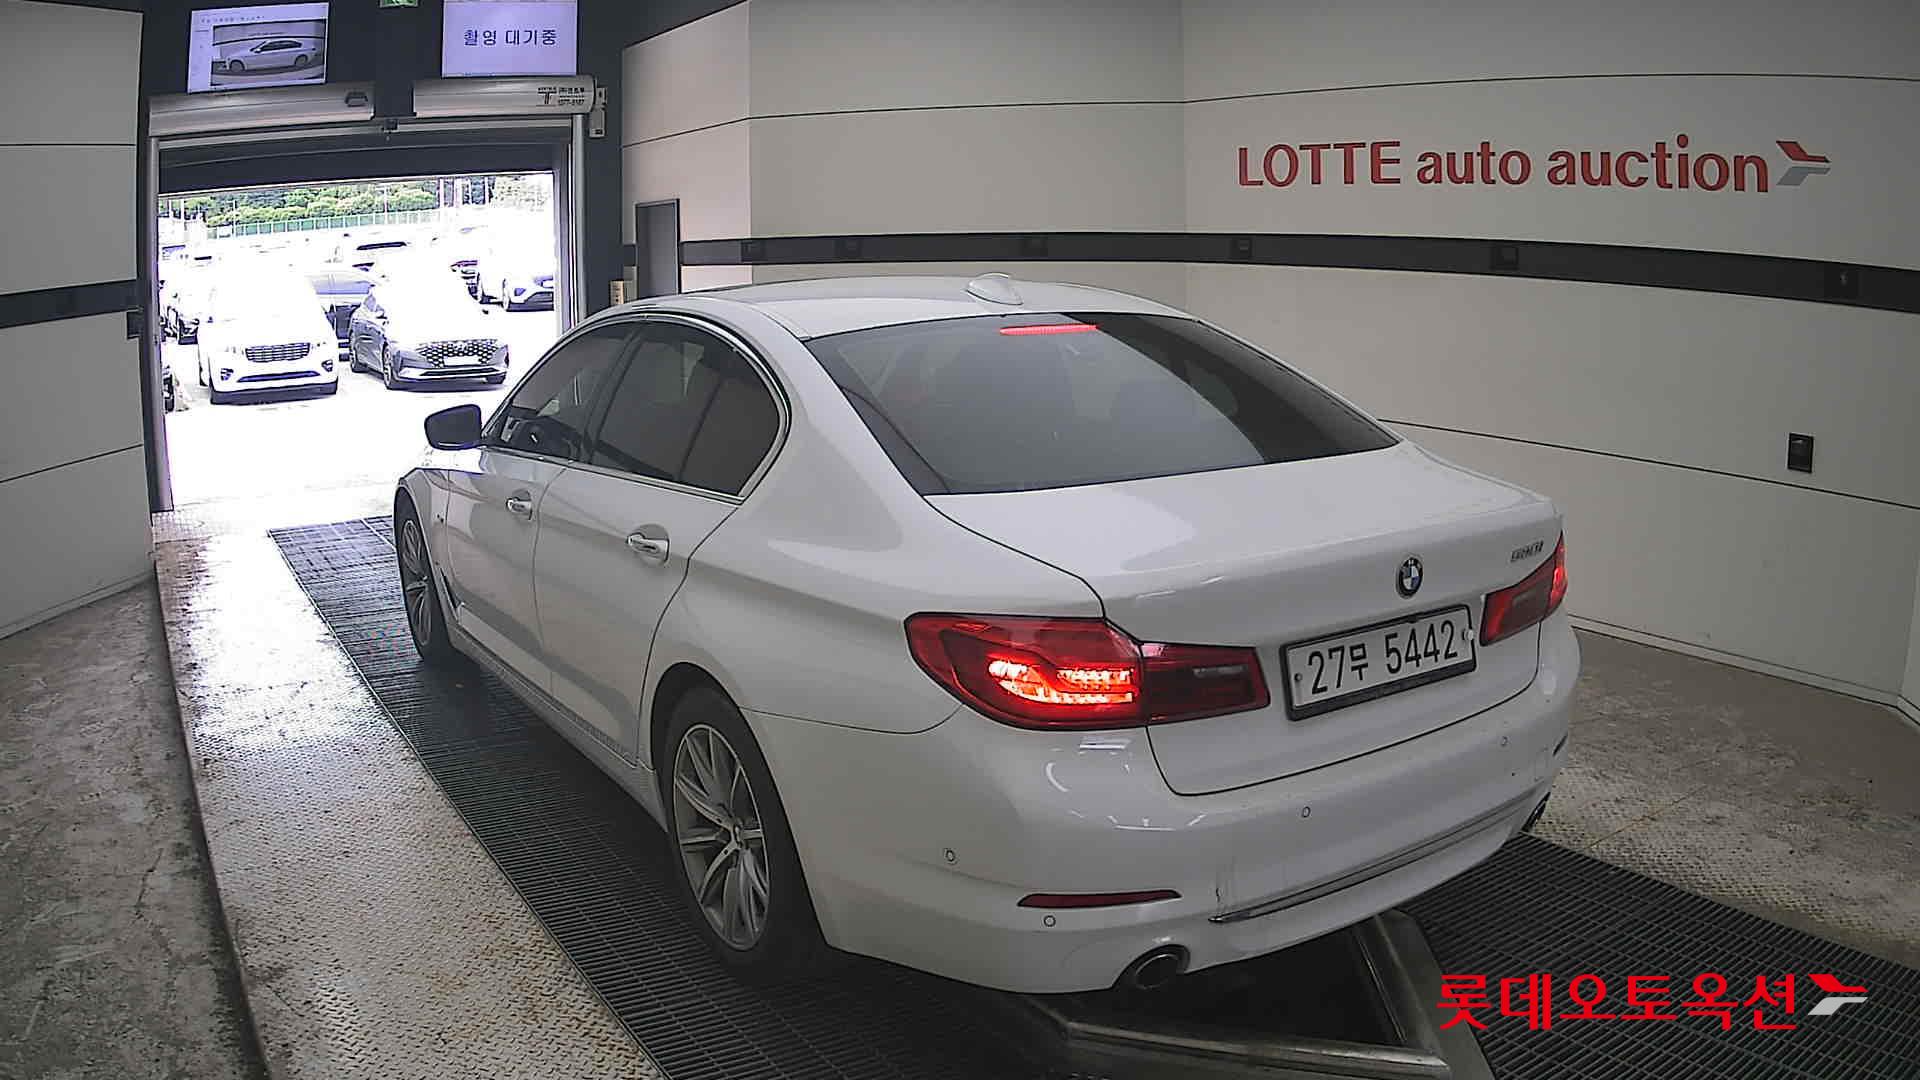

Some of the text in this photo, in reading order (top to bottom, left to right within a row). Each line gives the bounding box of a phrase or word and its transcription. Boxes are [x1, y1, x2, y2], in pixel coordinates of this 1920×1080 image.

[505, 29, 557, 46] 대기중
[1238, 134, 1768, 192] LOTTE auto auction
[1308, 620, 1458, 694] 27무 5442
